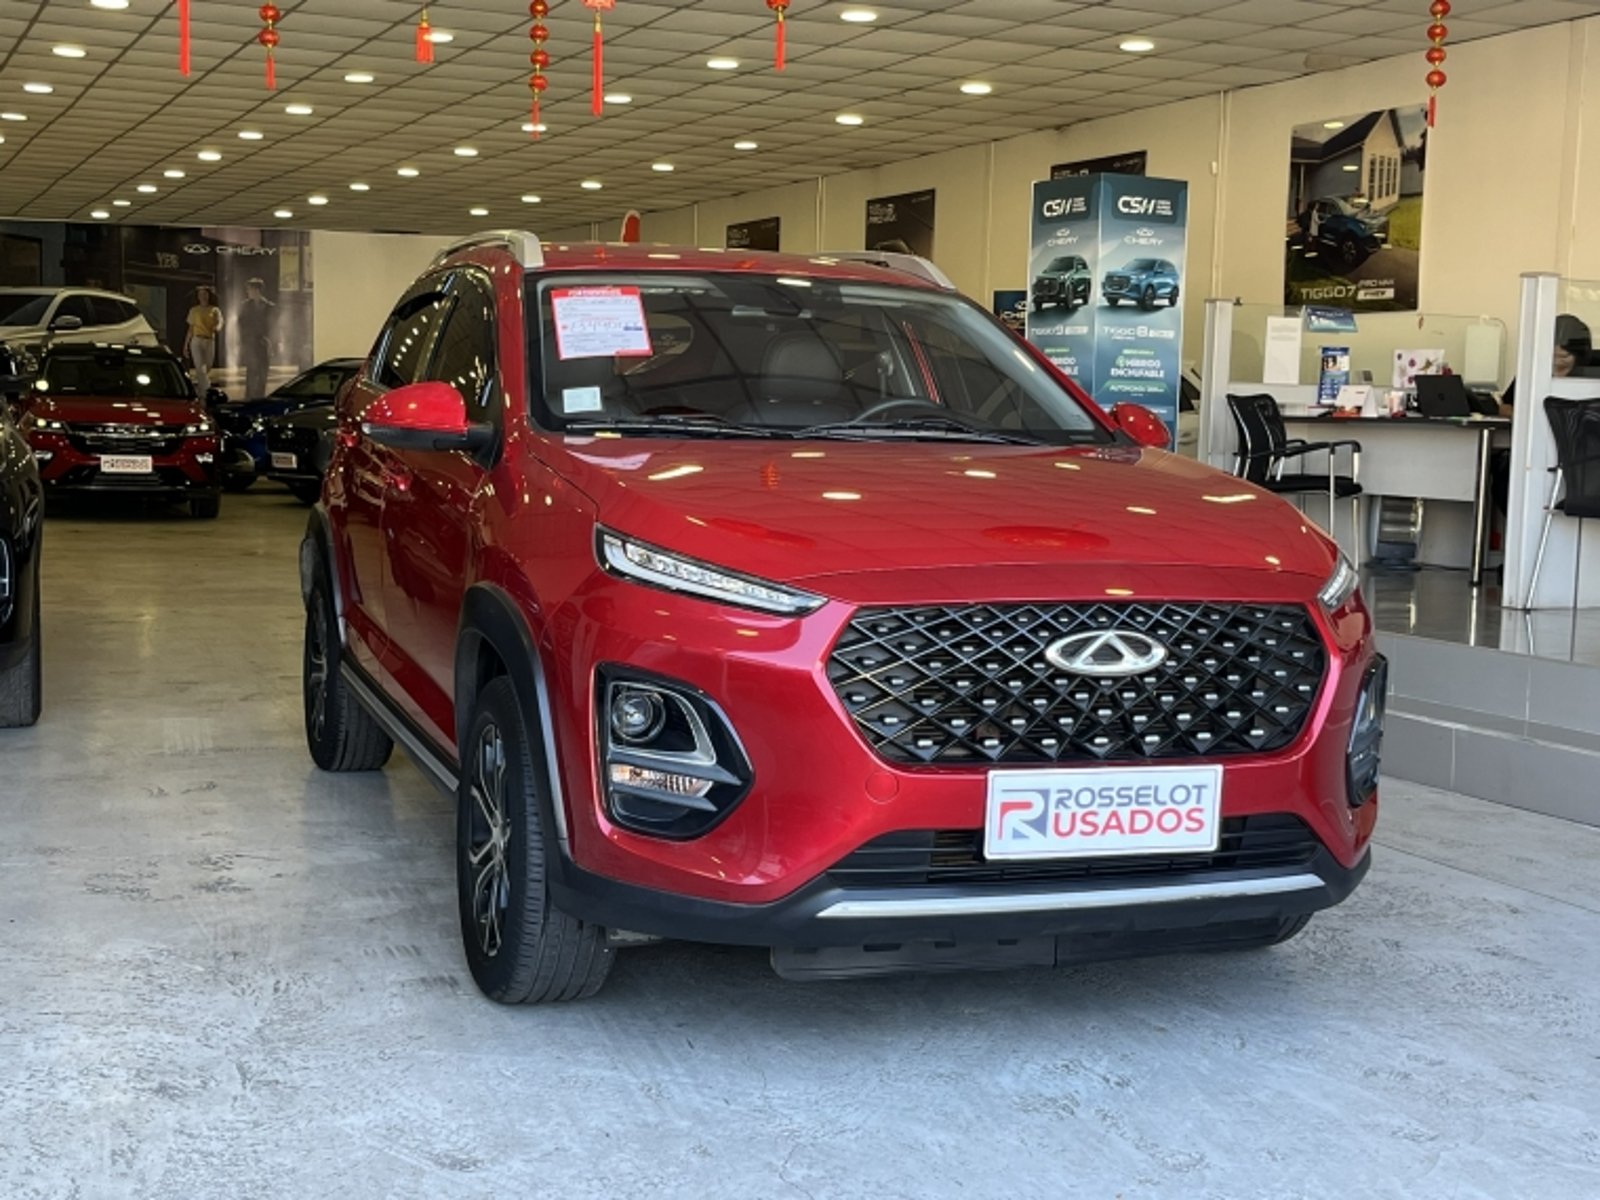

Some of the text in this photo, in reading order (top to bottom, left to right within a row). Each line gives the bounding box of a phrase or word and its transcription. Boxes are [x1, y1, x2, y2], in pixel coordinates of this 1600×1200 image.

[1047, 235, 1079, 247] CHERY
[1123, 235, 1164, 247] CHERY
[216, 245, 277, 256] CHERY
[1002, 310, 1026, 320] CHE
[1055, 784, 1208, 810] ROSSELOT
[1053, 807, 1206, 837] USADOS
